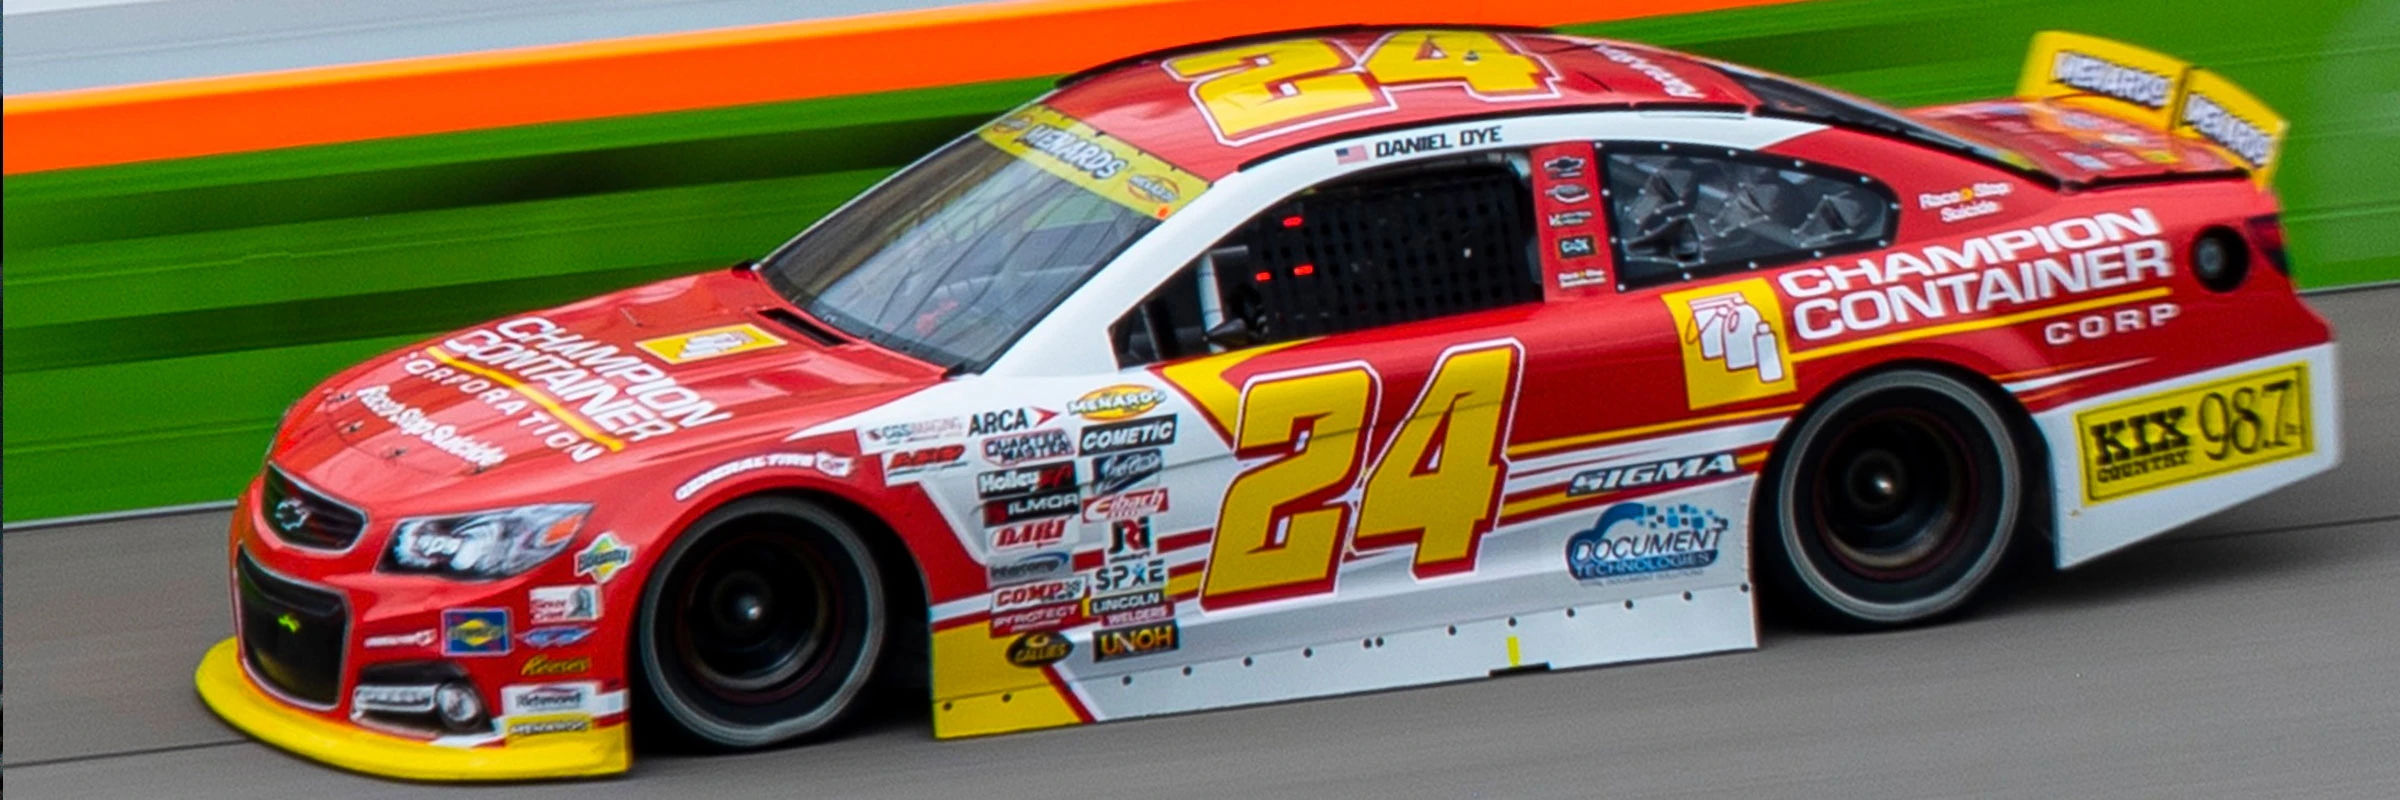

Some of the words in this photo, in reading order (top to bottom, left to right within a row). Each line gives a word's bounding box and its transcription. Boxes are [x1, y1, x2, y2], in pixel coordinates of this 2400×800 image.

[1164, 30, 1560, 146] 24
[1015, 123, 1128, 179] MENARDS
[1375, 133, 1453, 158] DANIEL
[1460, 125, 1502, 146] DYE
[1777, 209, 2162, 298] CHAMPION
[1794, 240, 2173, 341] CONTAINER
[2045, 303, 2181, 345] CORP
[445, 329, 675, 441] CONTAINER
[497, 317, 733, 428] CHAMPION
[1067, 390, 1167, 415] MENARDS
[968, 408, 1029, 437] ARCA
[1082, 420, 1173, 450] COMETIC
[2090, 406, 2190, 466] KIX
[980, 470, 1039, 493] Holley
[1200, 338, 1525, 614] 24
[1570, 453, 1736, 494] SIGMA
[2097, 449, 2189, 482] COUNTRY
[1008, 493, 1079, 515] ILMOR
[1574, 528, 1724, 564] DOCUMENT
[1576, 551, 1709, 577] TECHNOLOGIES
[997, 582, 1063, 606] COMP
[1092, 592, 1160, 613] LINCOLN
[1107, 606, 1167, 624] WELDERS
[1102, 625, 1172, 656] UNOH
